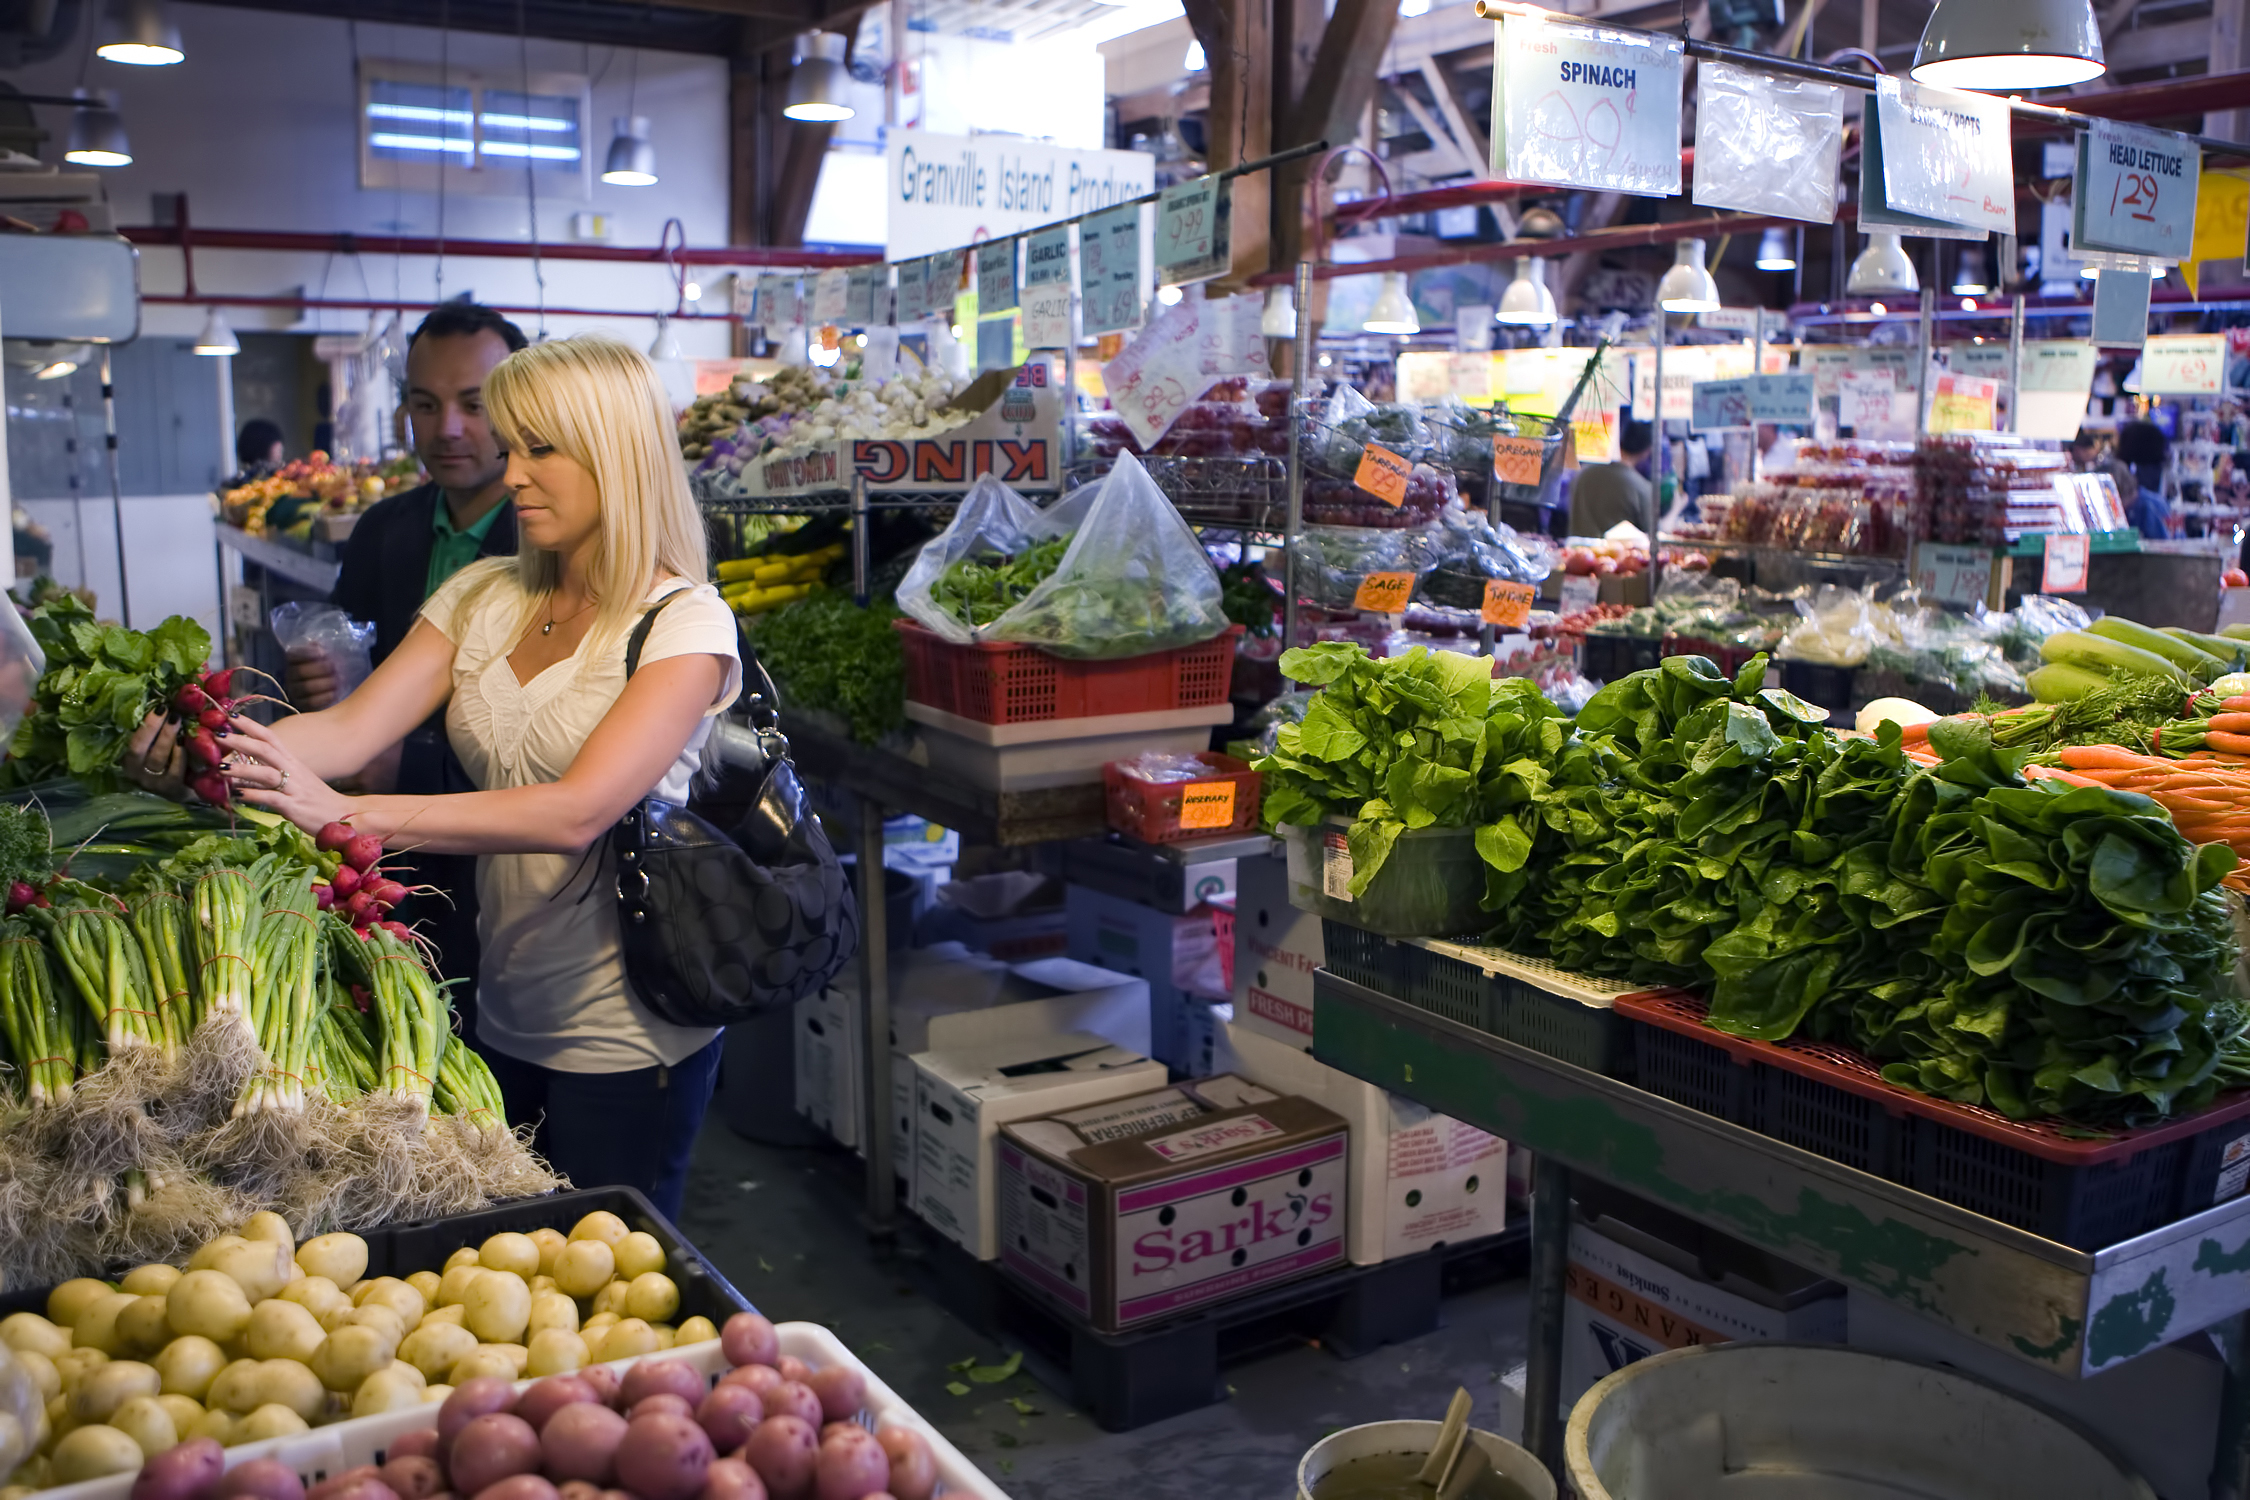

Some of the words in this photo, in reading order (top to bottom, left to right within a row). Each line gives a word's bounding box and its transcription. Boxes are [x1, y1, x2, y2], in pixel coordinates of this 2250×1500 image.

[1560, 60, 1637, 91] SPINACH
[2110, 143, 2136, 168] HEAD
[2138, 149, 2182, 178] LETTUCE
[900, 145, 987, 208] Granville
[998, 154, 1056, 214] Island
[1031, 242, 1066, 265] GARLIC
[1031, 297, 1069, 319] GARLIC
[853, 439, 1048, 483] KING
[1364, 576, 1408, 591] SAGE
[1185, 793, 1230, 805] ROSEMARY
[1248, 936, 1296, 968] VINCENT
[1250, 993, 1295, 1027] FRESH
[1178, 1123, 1258, 1153] Sark's
[1132, 1190, 1333, 1277] Sark's
[1173, 1274, 1250, 1303] SUNSHINE
[1615, 1263, 1670, 1302] Sunkist
[1694, 1304, 1767, 1338] MARKETED
